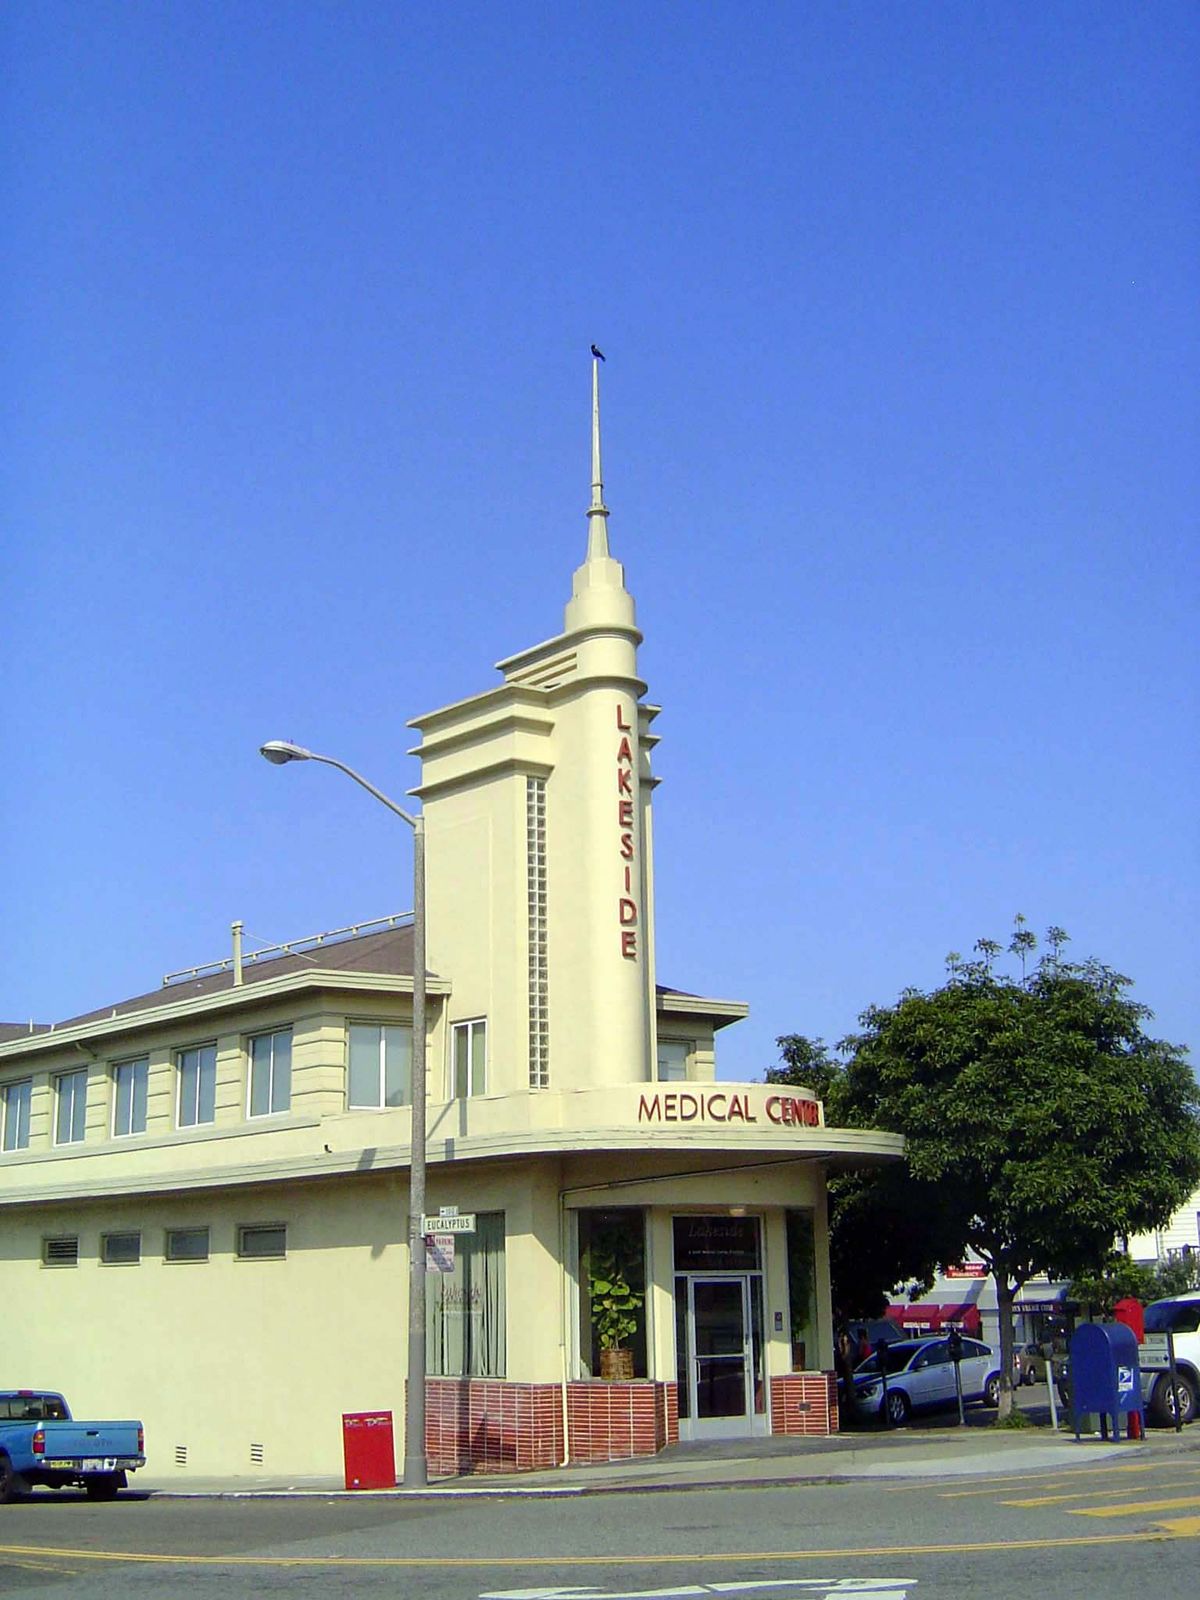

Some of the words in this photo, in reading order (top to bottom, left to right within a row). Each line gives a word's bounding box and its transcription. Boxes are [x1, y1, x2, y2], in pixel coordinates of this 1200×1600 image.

[616, 704, 637, 957] LAKESIDE
[638, 1093, 757, 1122] MEDICAL
[427, 1218, 470, 1230] EUCALYPTUS
